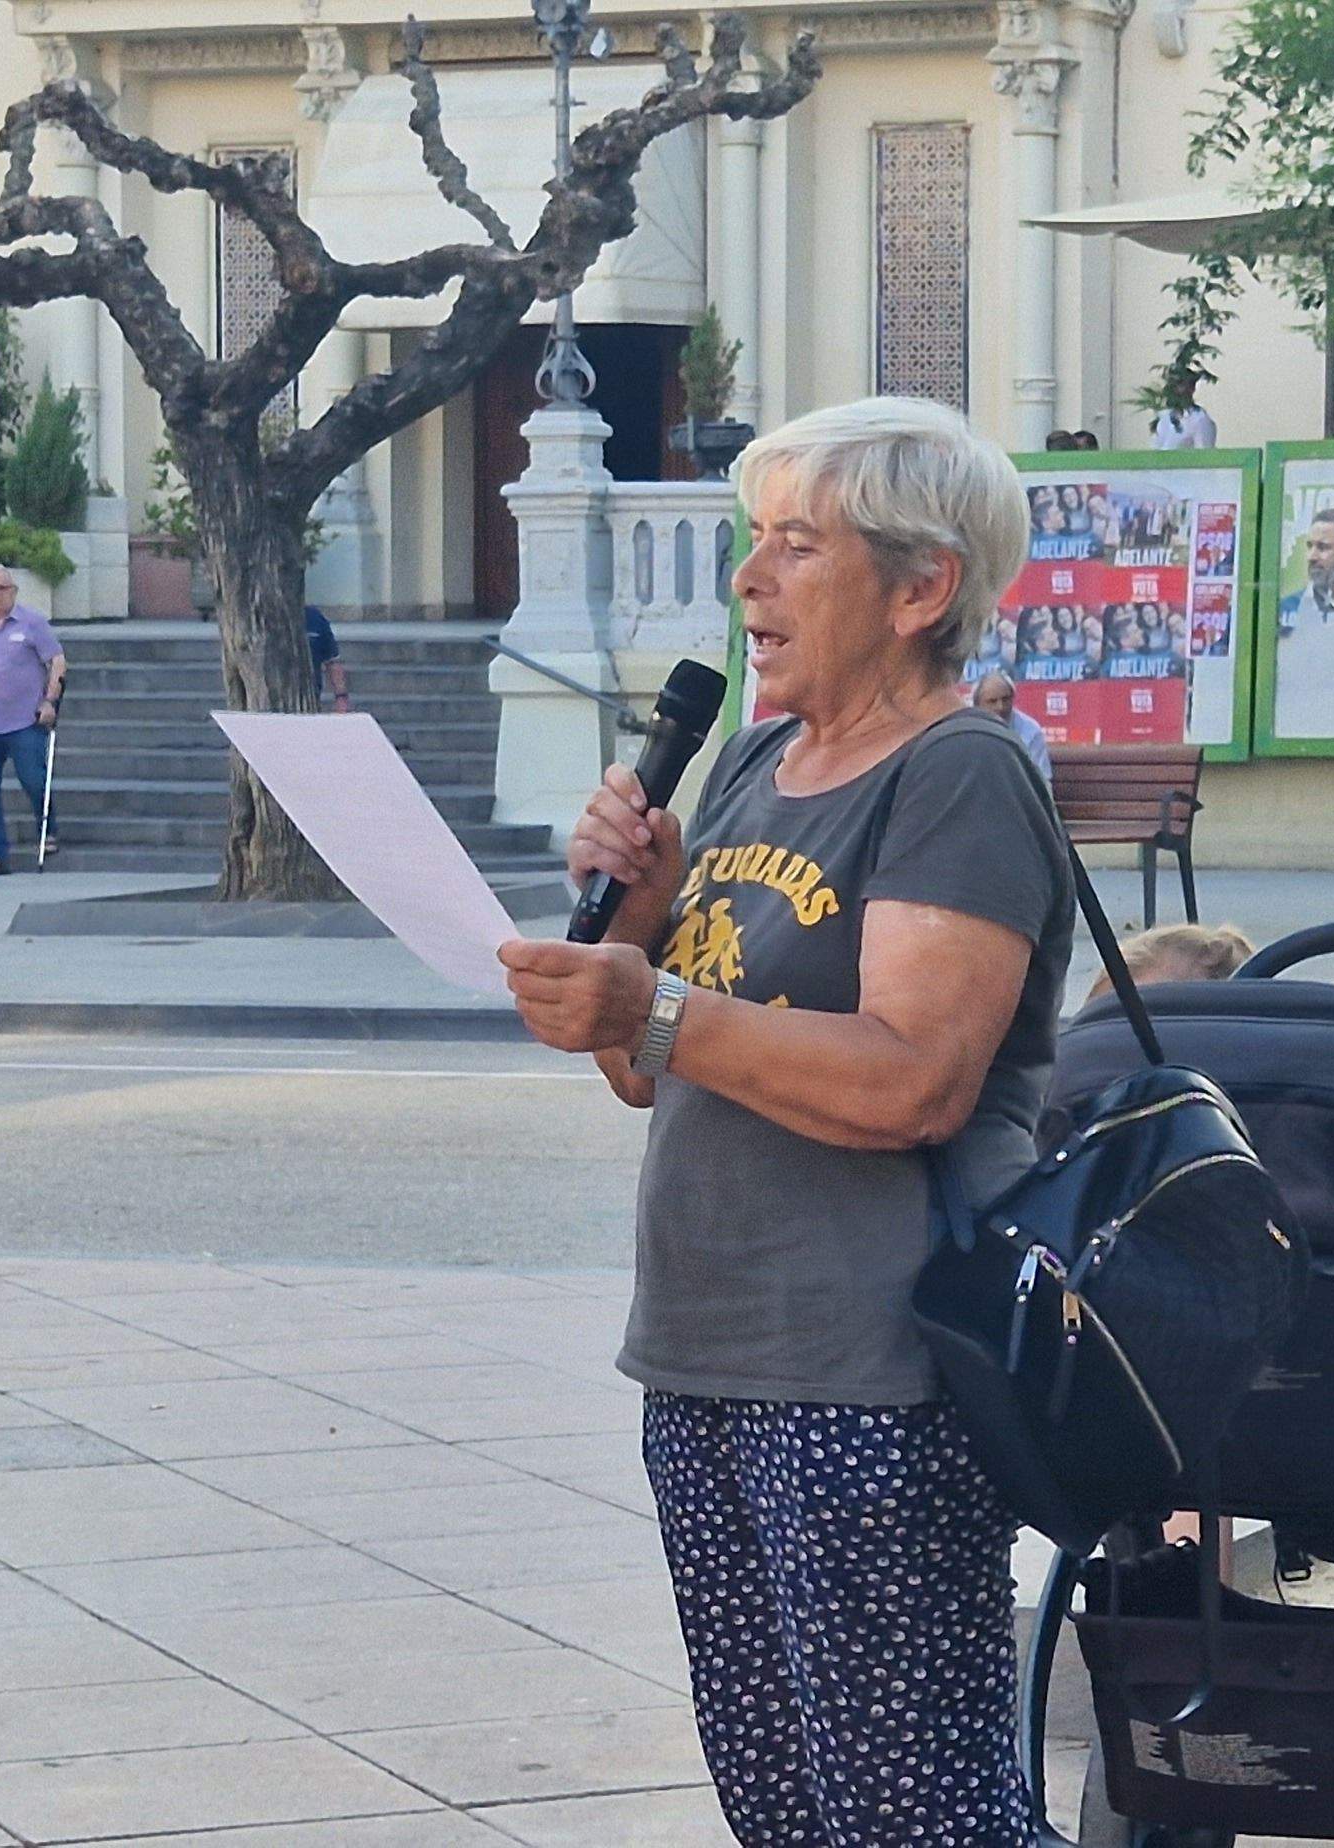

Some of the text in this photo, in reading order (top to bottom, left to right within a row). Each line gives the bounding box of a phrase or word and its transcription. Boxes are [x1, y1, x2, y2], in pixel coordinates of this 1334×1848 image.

[1031, 539, 1091, 560] ADELANTE
[1114, 547, 1173, 567] ADELANTE
[1025, 660, 1087, 681] ADELANTE
[1110, 657, 1171, 679] ADELANTE
